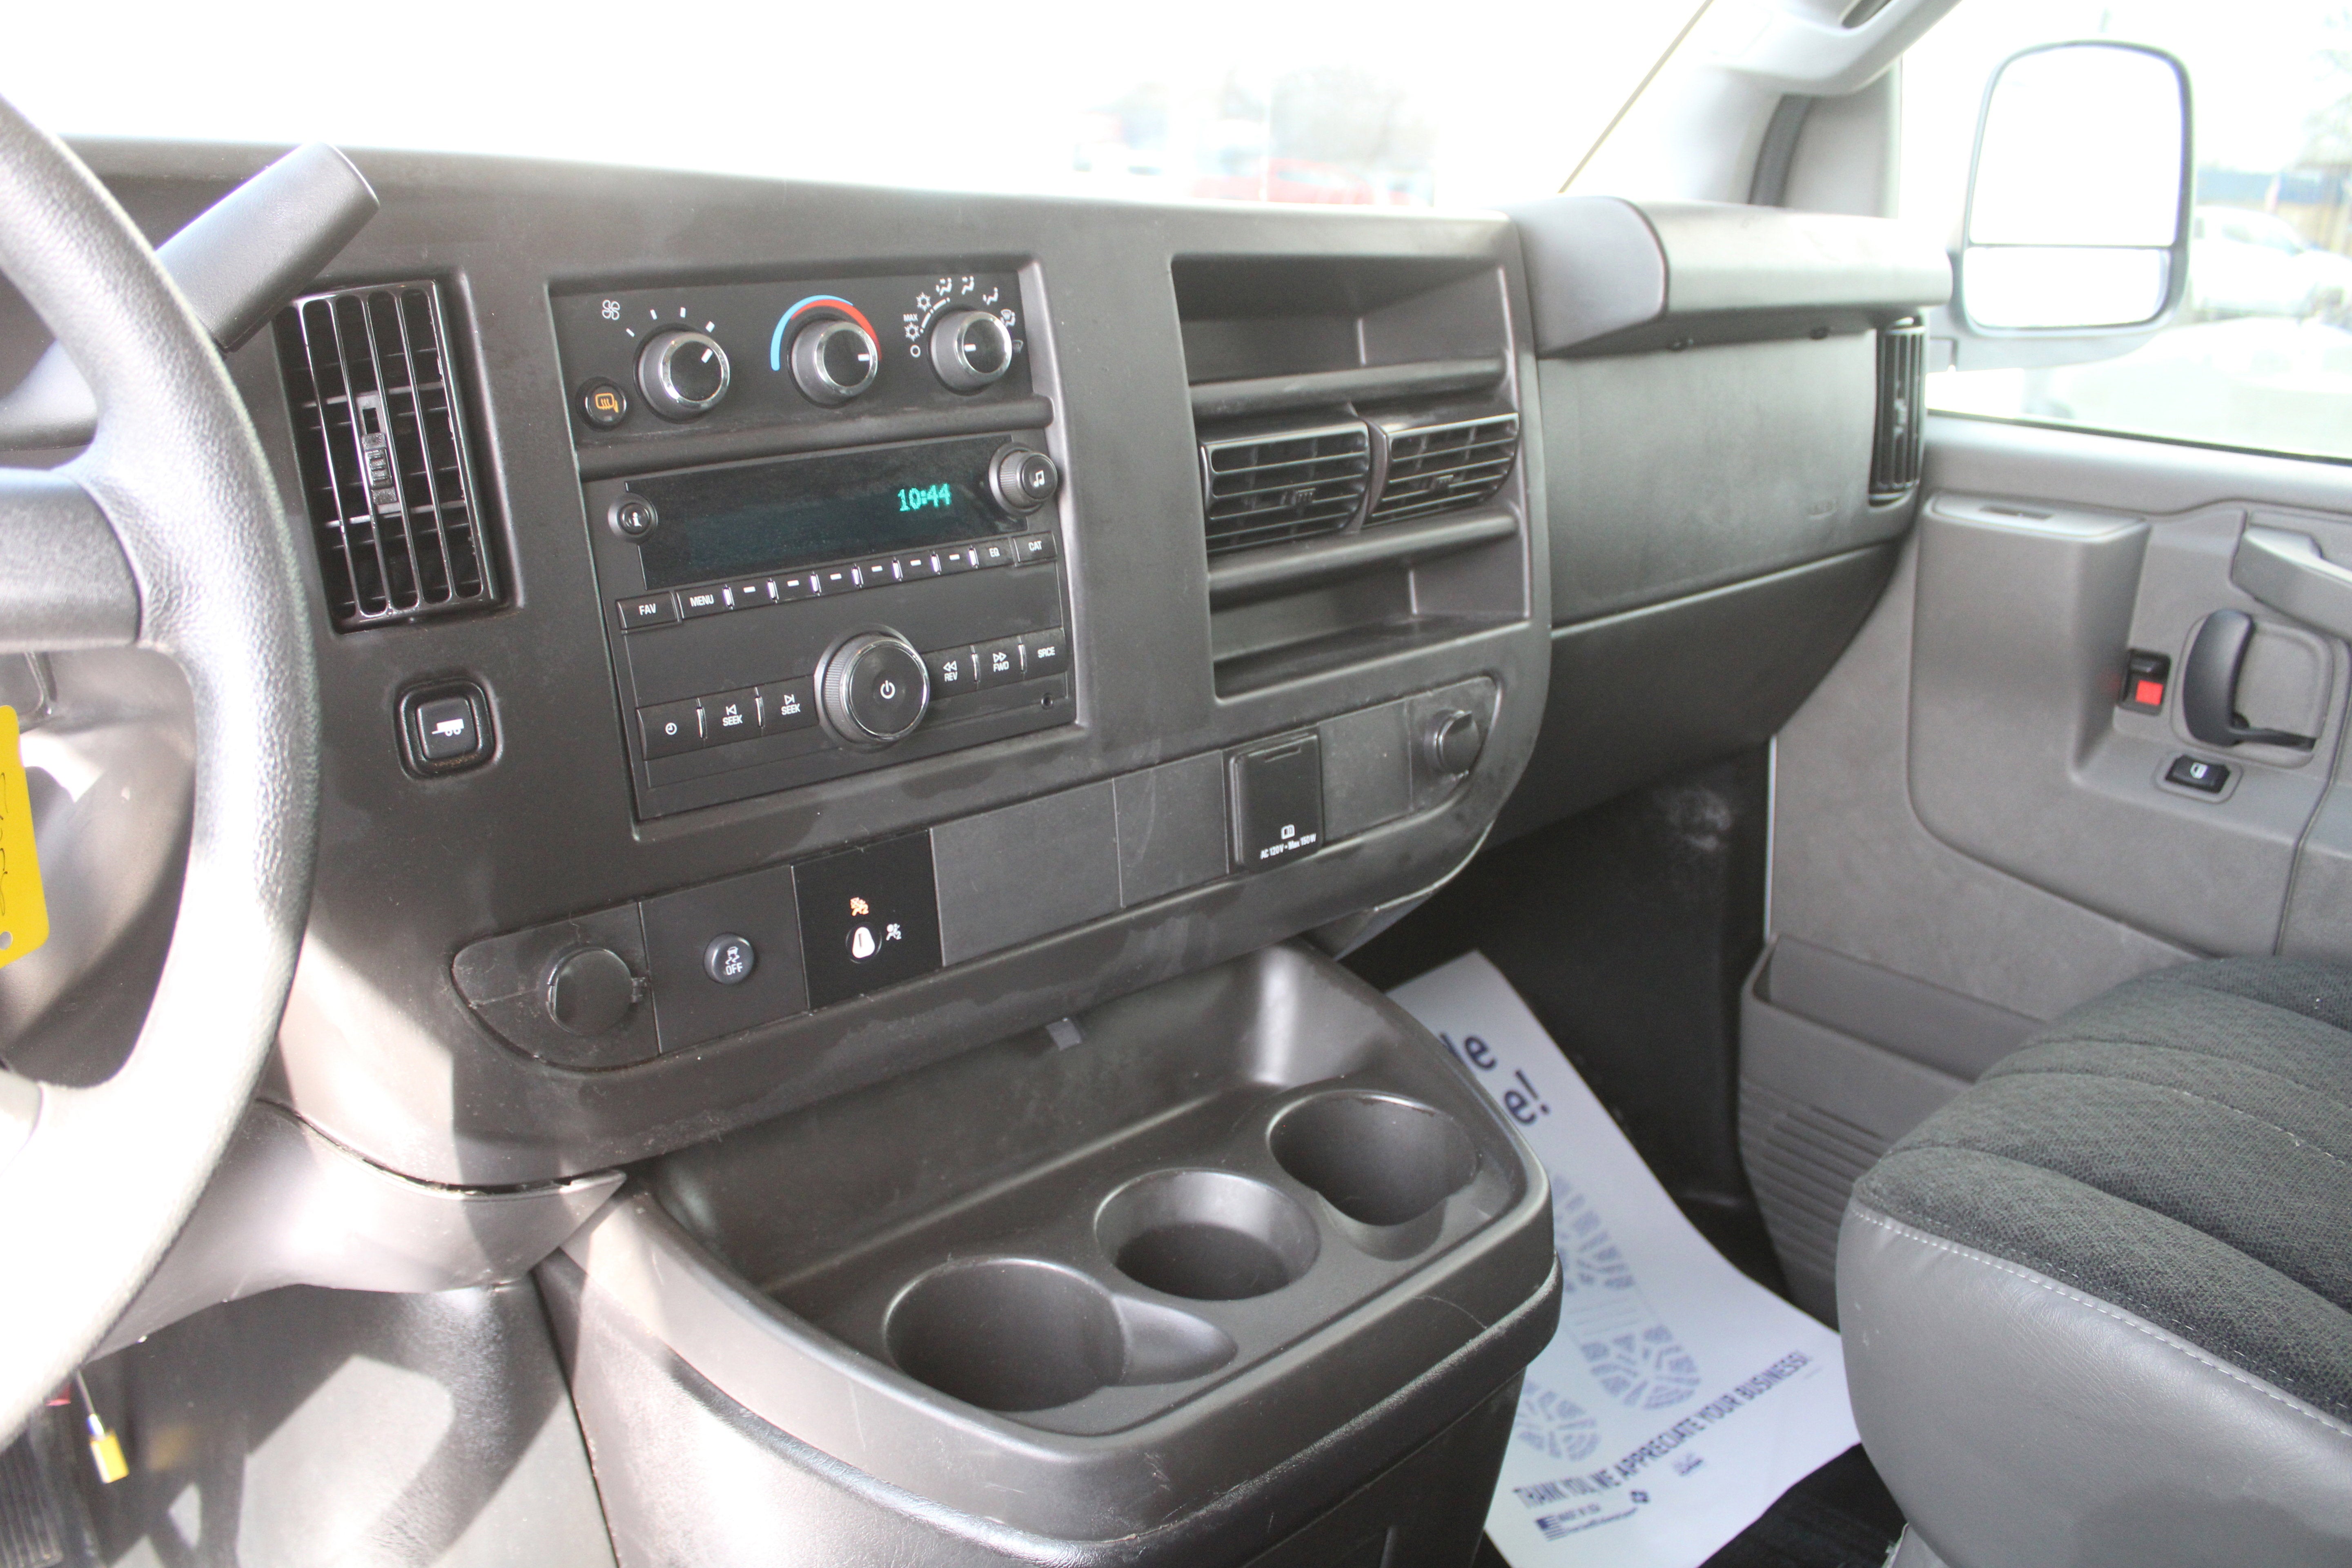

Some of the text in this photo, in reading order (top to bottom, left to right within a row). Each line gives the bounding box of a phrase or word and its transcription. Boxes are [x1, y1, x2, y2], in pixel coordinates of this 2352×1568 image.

[903, 313, 918, 322] MAX
[898, 483, 951, 511] 10:44
[1028, 540, 1042, 551] CAT
[988, 547, 1000, 558] EQ
[689, 594, 714, 607] MENU
[638, 603, 657, 615] FAV
[1037, 646, 1056, 658] SRCE
[993, 661, 1009, 672] FWD
[944, 672, 958, 682] REV
[781, 703, 801, 715] SEEK
[722, 715, 743, 726] SEEK
[1260, 848, 1269, 860] AC
[1269, 843, 1284, 856] 120V
[1287, 840, 1300, 850] Max
[725, 962, 743, 975] OFF
[1512, 1481, 1569, 1509] THANK
[1589, 1468, 1621, 1489] WE
[1614, 1418, 1706, 1481] APPRECIATE
[1695, 1393, 1743, 1424] YOUR
